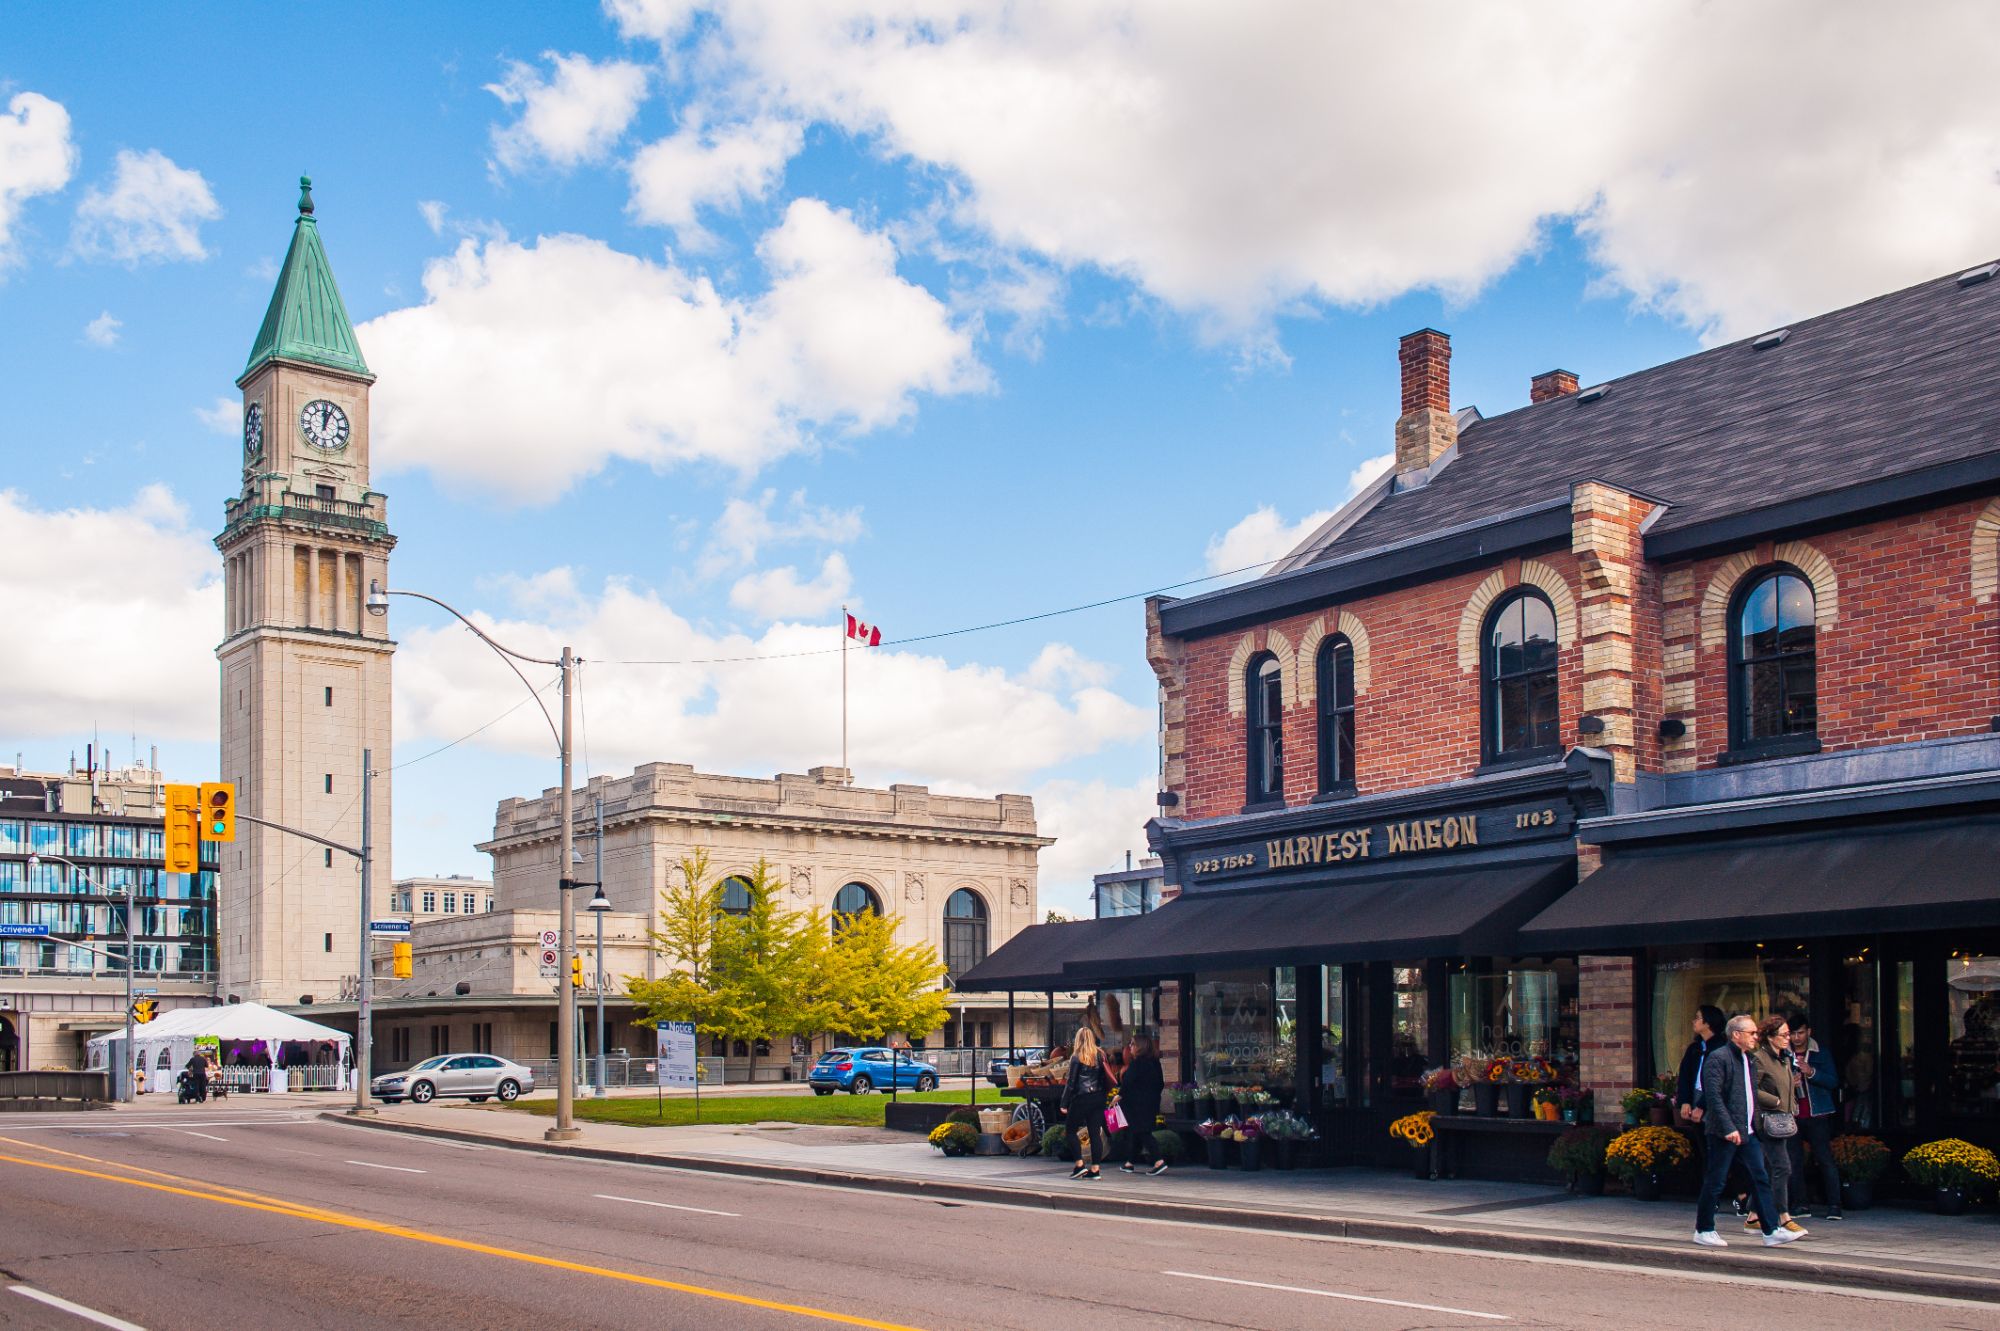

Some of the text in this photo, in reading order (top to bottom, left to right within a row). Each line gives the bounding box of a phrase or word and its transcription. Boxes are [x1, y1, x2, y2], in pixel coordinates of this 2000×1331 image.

[1515, 809, 1556, 829] 1103
[1266, 815, 1478, 869] HARVEST WAGON
[1194, 853, 1256, 874] 923 7542
[669, 1021, 693, 1034] Notice
